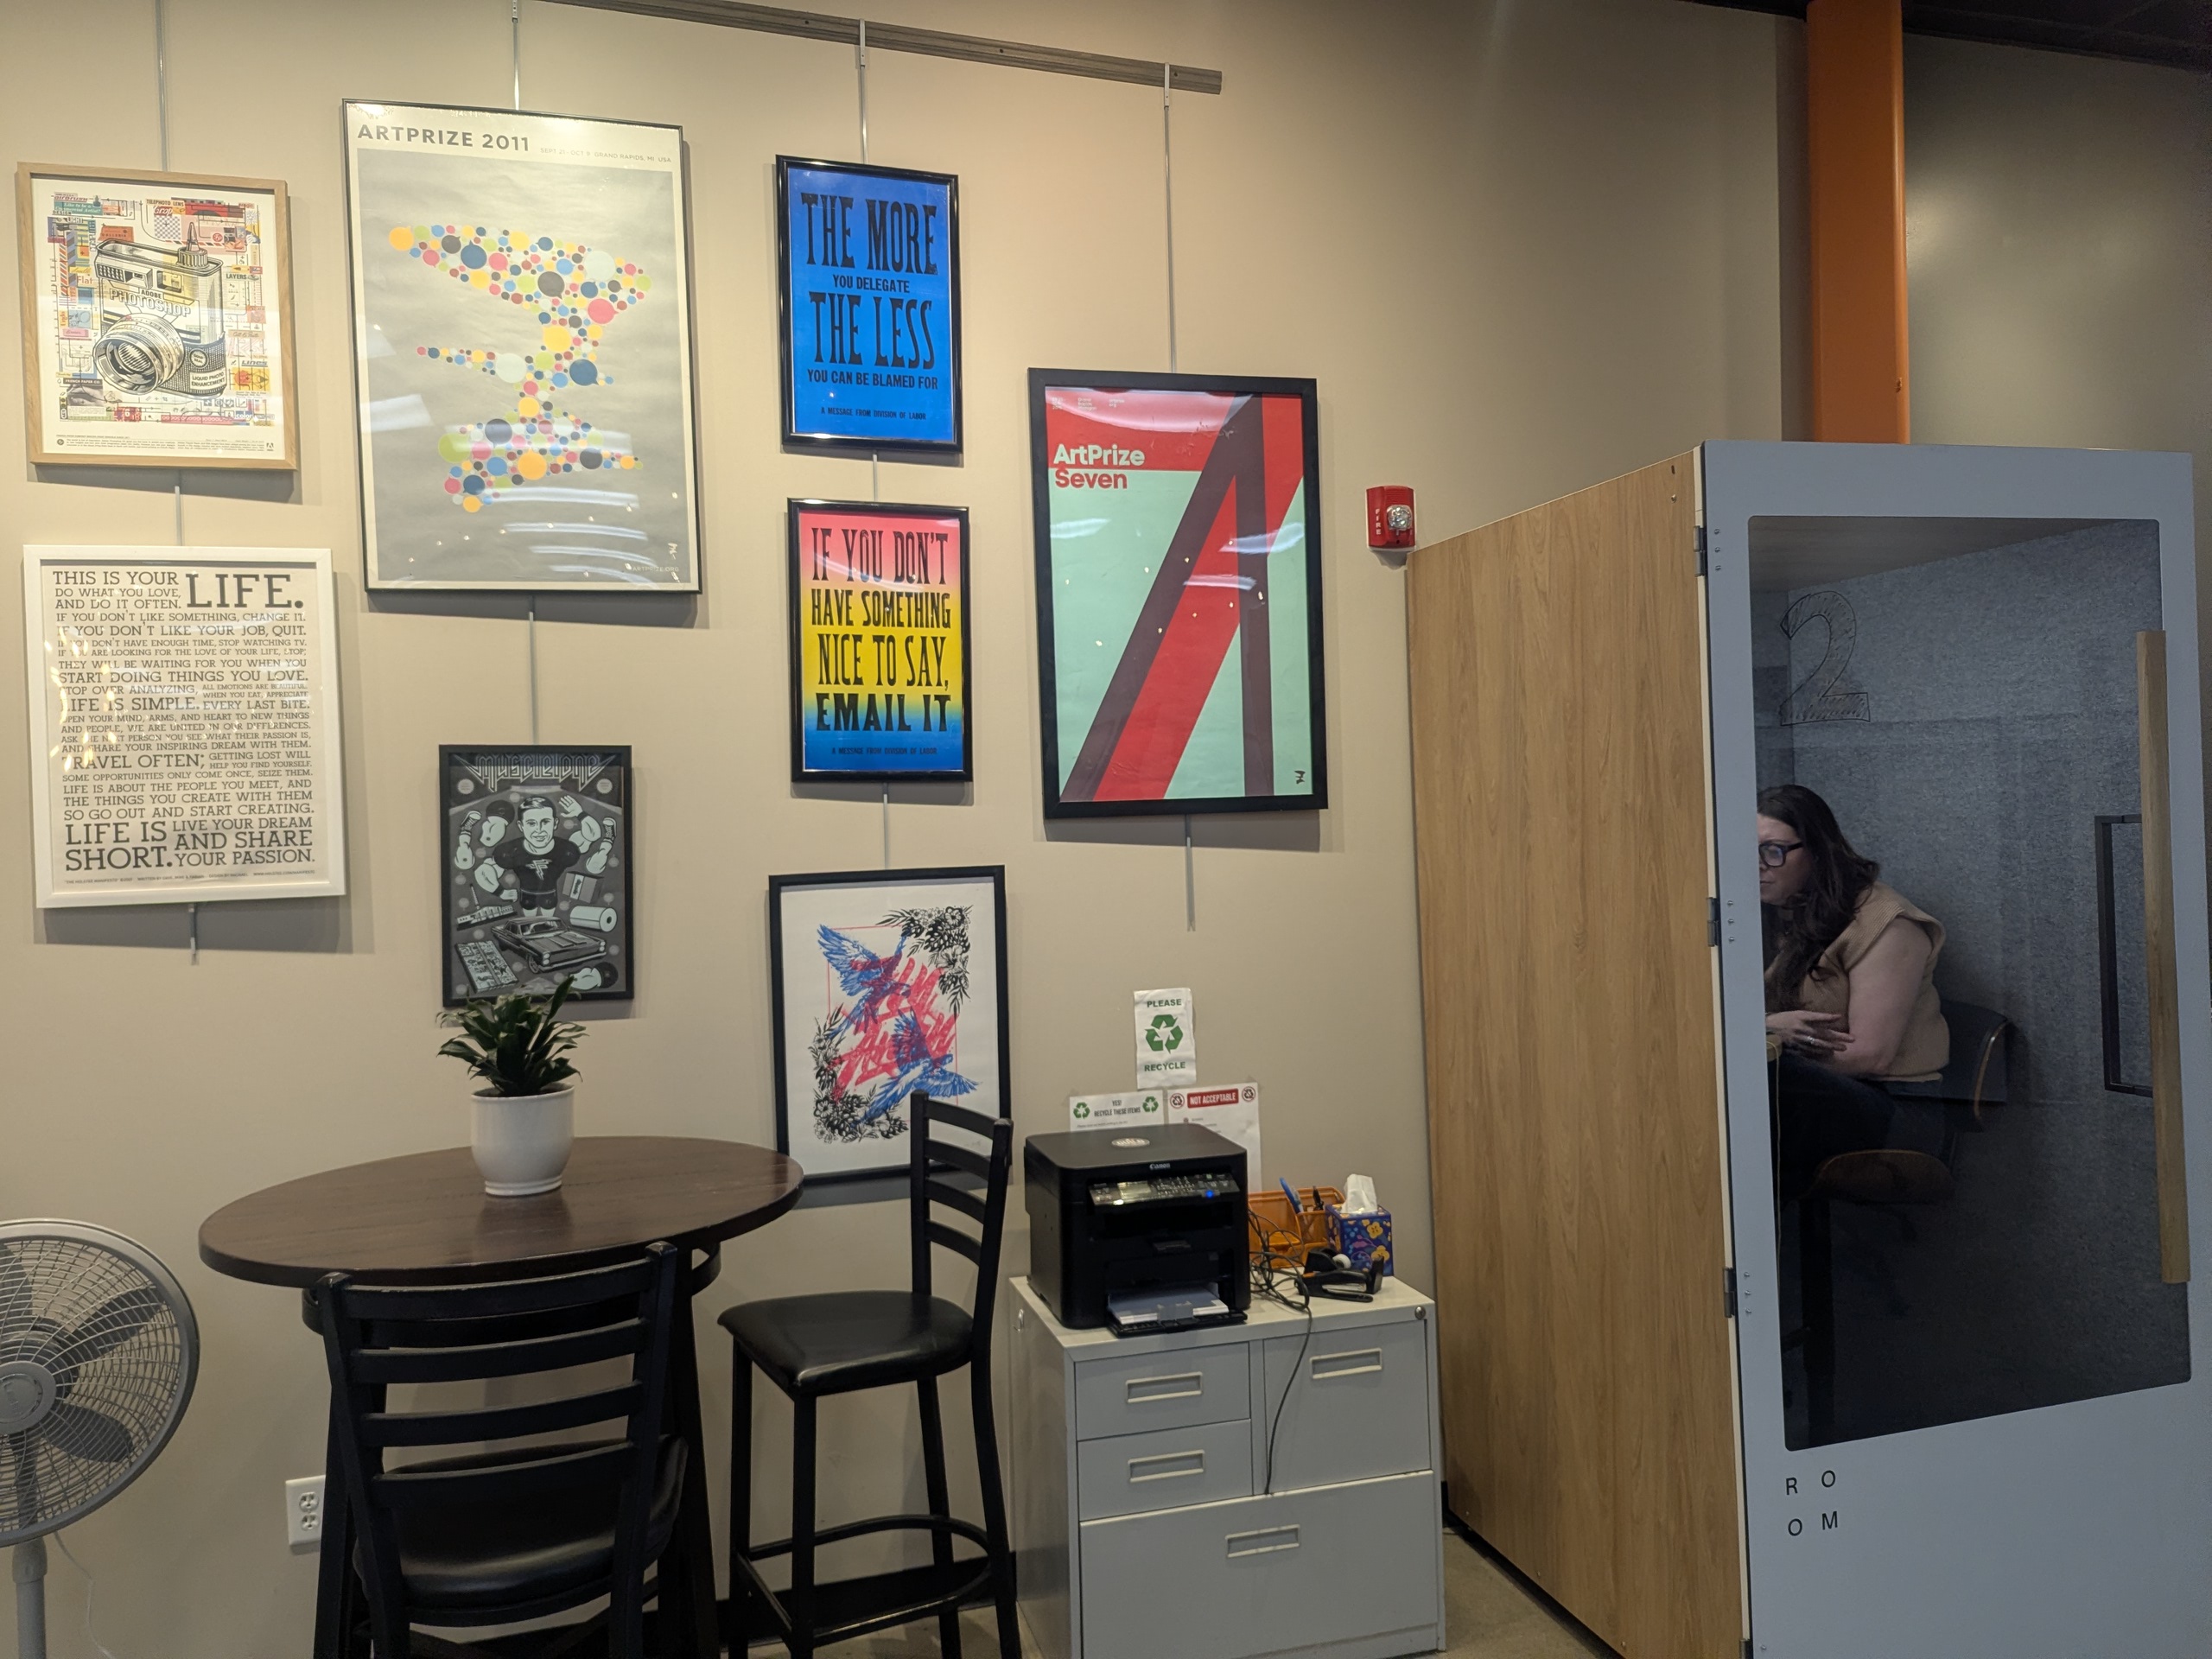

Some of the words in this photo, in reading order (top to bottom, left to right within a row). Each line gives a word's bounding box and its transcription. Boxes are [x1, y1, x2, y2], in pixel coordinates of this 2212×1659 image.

[358, 124, 474, 147] ARTPRIZE
[482, 133, 529, 152] 2011
[801, 192, 855, 269] THE
[865, 198, 938, 276] MORE
[77, 276, 92, 284] Flat
[833, 274, 854, 289] YOU
[856, 276, 910, 293] DELEGATE
[141, 289, 162, 299] ADOBE
[110, 288, 190, 318] PHOTOSHOP
[808, 291, 863, 365] THE
[873, 296, 935, 370] LESS
[191, 377, 225, 386] ENHANCEMENT
[209, 372, 224, 380] PHOTO
[807, 369, 828, 383] YOU
[831, 371, 853, 385] CAN
[856, 372, 870, 385] BE
[873, 373, 915, 388] BLAMED
[918, 375, 938, 389] FOR
[828, 407, 853, 416] MESSAGE
[855, 409, 871, 417] FROM
[874, 410, 897, 418] DIVISION
[899, 410, 906, 419] OF
[909, 411, 926, 420] LABOR
[1053, 443, 1146, 466] ArtPrize
[1055, 467, 1128, 489] Seven
[811, 527, 832, 581] IF
[841, 529, 884, 582] YOU
[893, 531, 949, 585] DON'T
[53, 571, 96, 585] THIS
[103, 571, 120, 585] IS
[126, 571, 179, 585] YOUR
[185, 573, 304, 608] LIFE.
[55, 588, 73, 597] DO
[79, 588, 114, 597] WHAT
[120, 588, 143, 597] YOU
[148, 588, 181, 599] LOVE,
[55, 600, 85, 608] AND
[91, 600, 111, 608] DO
[117, 599, 128, 608] IT
[134, 599, 181, 608] OFTEN.
[811, 588, 854, 626] HAVE
[861, 590, 951, 629] SOMETHING
[56, 613, 67, 621] IF
[72, 613, 94, 621] YOU
[99, 609, 135, 621] DON'T
[140, 613, 164, 621] LIKE
[168, 613, 240, 622] SOMETHING,
[243, 613, 289, 621] CHANGE
[294, 613, 306, 621] IT.
[75, 626, 104, 636] YOU
[110, 621, 155, 636] DON'T
[161, 626, 192, 636] LIKE
[197, 626, 235, 636] YOUR
[241, 626, 269, 637] JOB,
[272, 626, 307, 637] QUIT.
[141, 659, 191, 668] WAITING
[194, 659, 216, 668] FOR
[220, 659, 242, 668] YOU
[817, 633, 863, 685] NICE
[872, 634, 897, 686] TO
[906, 636, 949, 690] SAY,
[1778, 590, 1871, 727] 2
[59, 672, 103, 683] START
[111, 671, 162, 683] DOING
[168, 671, 225, 683] THINGS
[230, 671, 261, 682] YOU
[267, 671, 308, 682] LOVE.
[816, 692, 912, 731] EMAIL
[923, 694, 951, 732] IT
[137, 753, 205, 769] OFTEN;
[209, 752, 253, 760] GETTING
[257, 751, 281, 760] LOST
[286, 750, 311, 759] WILL
[64, 785, 88, 794] LIFE
[93, 785, 104, 793] IS
[108, 784, 146, 792] ABOUT
[150, 783, 172, 791] THE
[177, 782, 217, 791] PEOPLE
[221, 781, 245, 790] YOU
[249, 780, 283, 790] MEET,
[288, 779, 312, 788] AND
[64, 797, 89, 806] THE
[95, 795, 144, 805] THINGS
[149, 794, 176, 804] YOU
[181, 792, 231, 803] CREATE
[236, 791, 271, 801] WITH
[276, 791, 313, 800] THEM
[64, 810, 84, 820] SO
[88, 809, 111, 819] GO
[117, 808, 146, 818] OUT
[152, 807, 184, 817] AND
[190, 805, 232, 816] START
[238, 803, 315, 815] CREATING.
[173, 820, 207, 831] LIVE
[212, 818, 254, 830] YOUR
[258, 817, 313, 829] DREAM
[66, 822, 130, 845] LIFE
[140, 821, 167, 842] IS
[175, 832, 227, 850] AND
[235, 830, 313, 849] SHARE
[66, 846, 173, 871] SHORT.
[175, 852, 226, 867] YOUR
[232, 849, 315, 864] PASSION.
[1147, 998, 1182, 1007] PLEASE
[1144, 1061, 1185, 1071] RECYCLE
[1190, 1096, 1201, 1105] NOT
[1202, 1092, 1236, 1103] ACCEPTABLE
